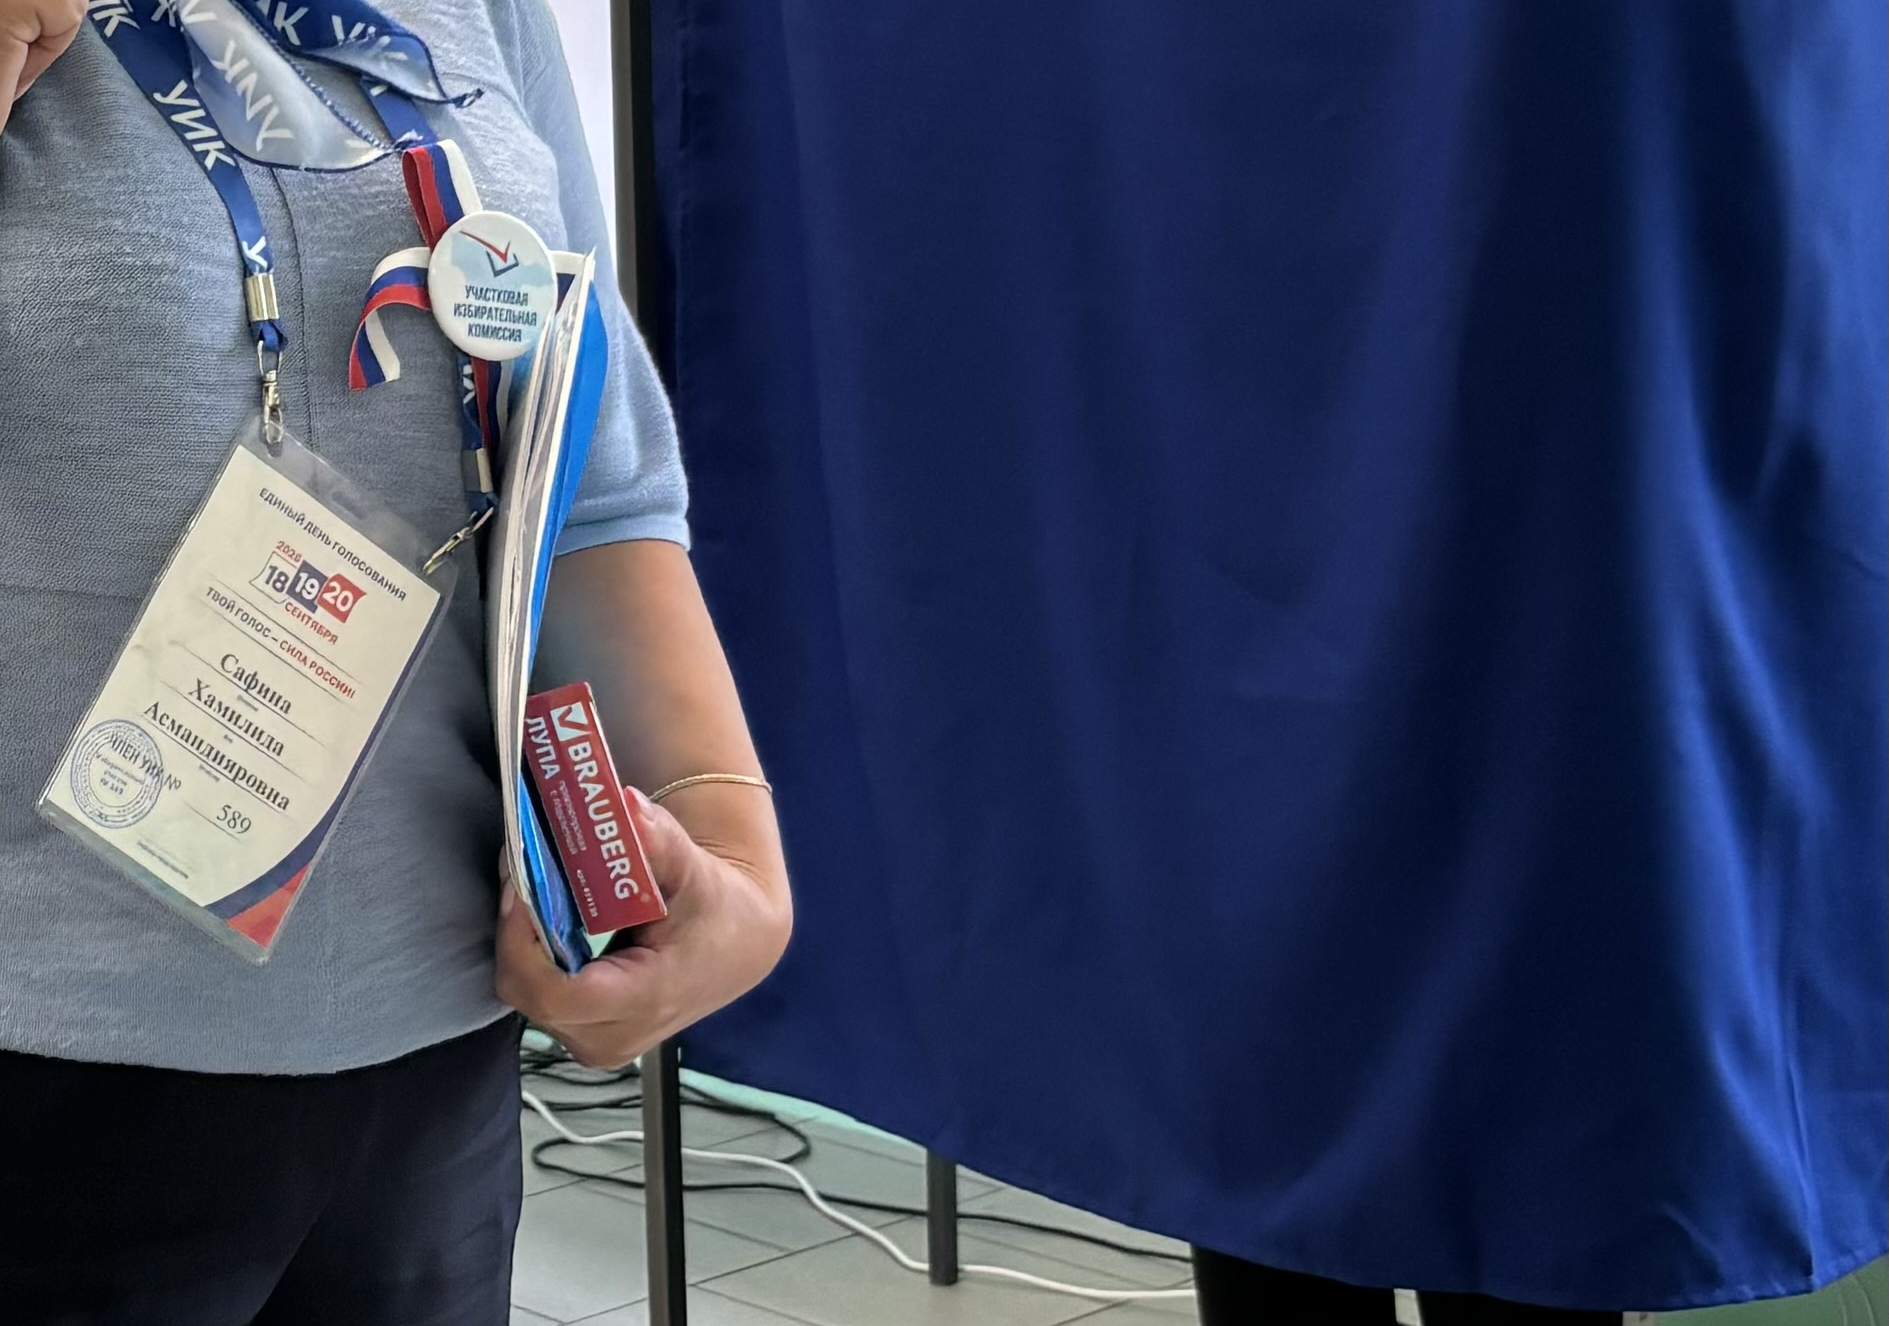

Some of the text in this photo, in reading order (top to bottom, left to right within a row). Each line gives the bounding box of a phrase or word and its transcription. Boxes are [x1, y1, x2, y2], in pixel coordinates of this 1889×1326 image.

[152, 79, 237, 172] УИК
[453, 302, 538, 326] ИЗБИРАТЕЛЬНАЯ
[465, 284, 529, 306] УЧАСТКОВАЯ
[468, 322, 523, 342] КОМИССИЯ
[259, 487, 407, 601] ЕДИНЫЙ ДЕНЬ ГОЛОСОВАНИЯ
[264, 564, 354, 612] 18 19 20
[206, 586, 235, 613] ТВОЙ
[234, 605, 271, 639] ГОЛОС
[279, 640, 309, 667] СИЛА
[284, 602, 339, 645] СЕНТЯБРЯ
[220, 653, 292, 715] Сафина
[188, 677, 285, 757] Хамилида
[524, 716, 561, 780] ЛУПА
[143, 701, 290, 811] Асмандияровна
[216, 804, 252, 834] 589
[568, 741, 640, 900] BRAUBERG
